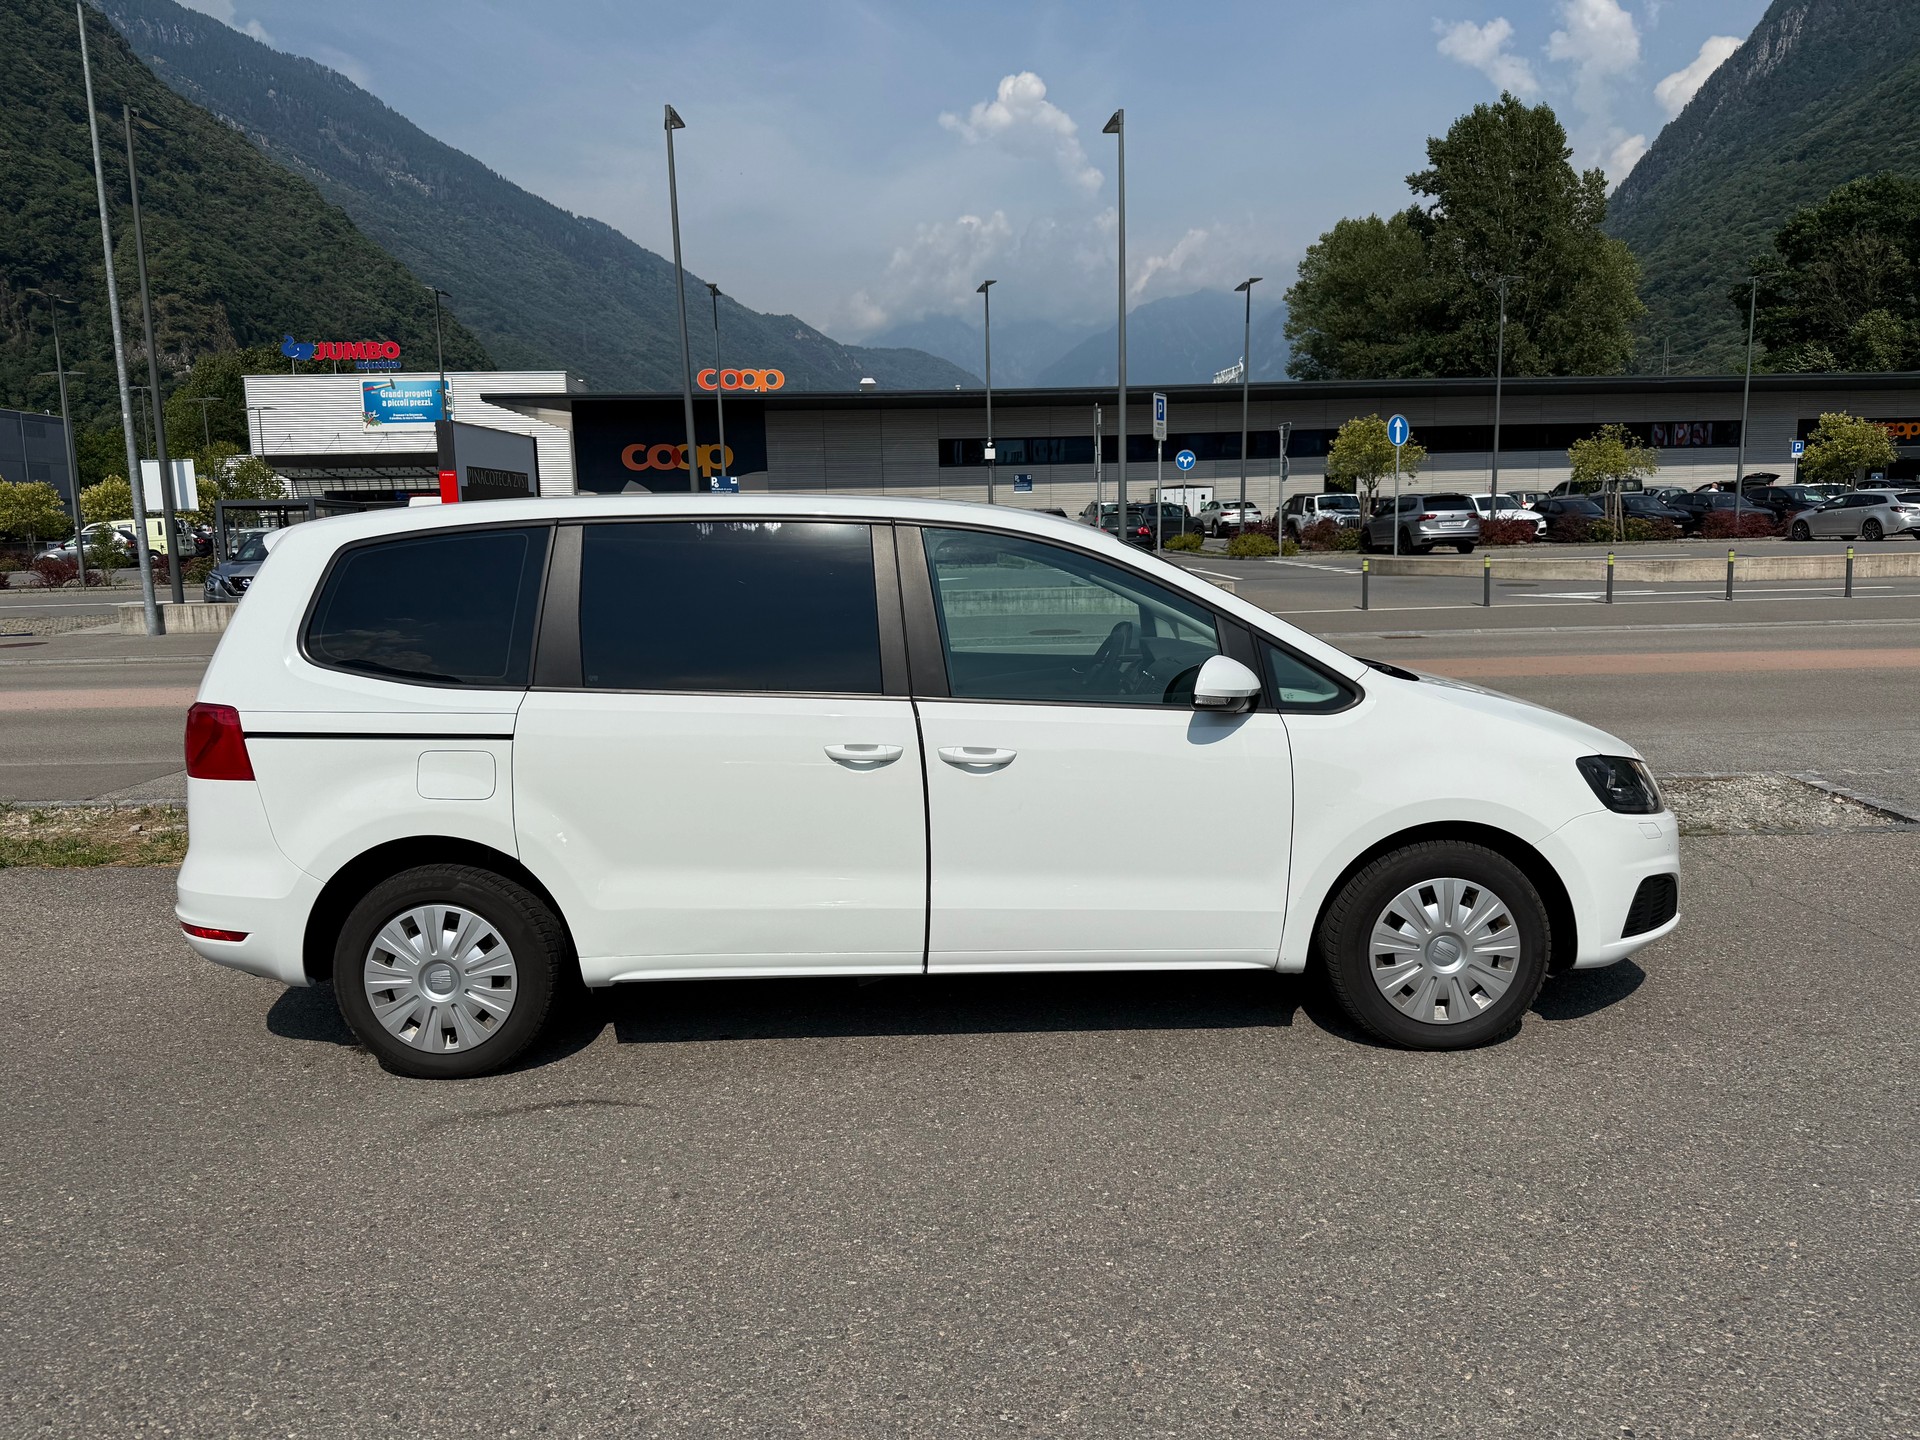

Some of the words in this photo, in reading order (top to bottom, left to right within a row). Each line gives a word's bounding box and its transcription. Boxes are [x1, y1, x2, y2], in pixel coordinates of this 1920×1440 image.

[314, 341, 400, 360] JUMBO
[697, 368, 785, 392] coop
[380, 389, 404, 399] Grandi
[404, 389, 432, 399] progetti
[387, 399, 409, 408] piccoli
[409, 398, 433, 407] prezzi.
[1795, 443, 1801, 452] P
[621, 443, 734, 478] coop
[467, 468, 512, 487] PINACOTECA
